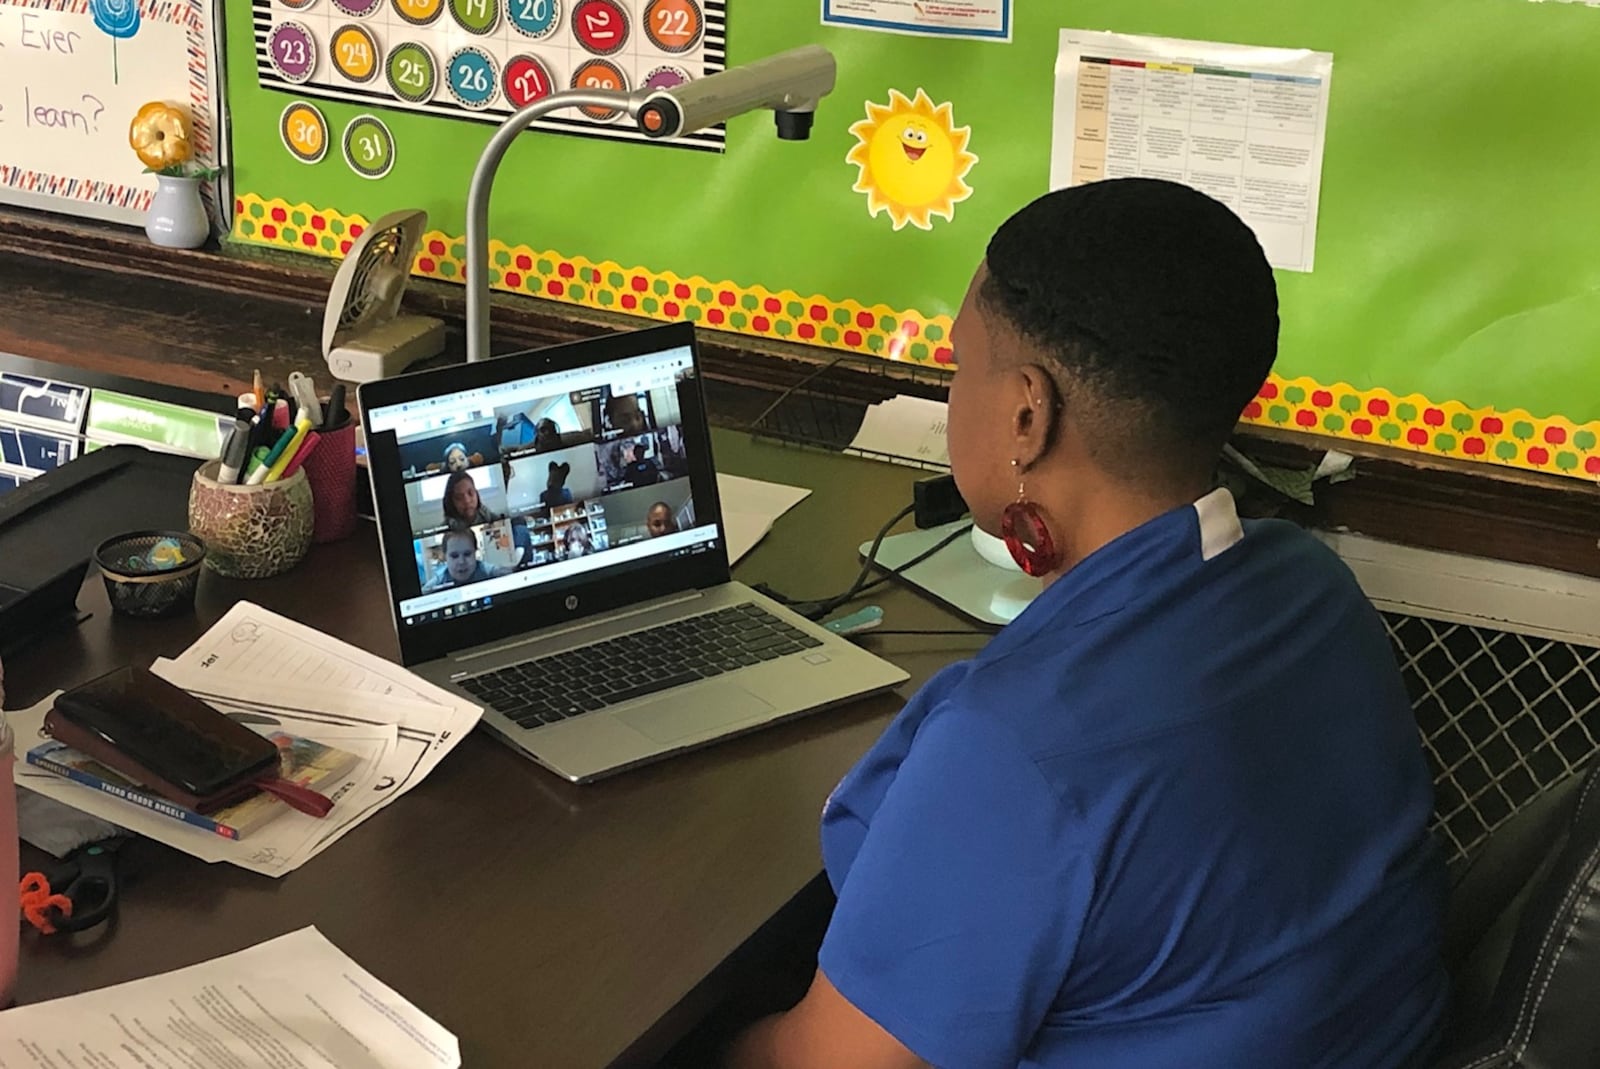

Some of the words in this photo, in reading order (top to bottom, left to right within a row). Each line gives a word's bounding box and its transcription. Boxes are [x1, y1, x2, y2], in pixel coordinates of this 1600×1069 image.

[22, 13, 81, 54] Ever
[519, 0, 548, 21] 20
[586, 11, 614, 39] 21
[657, 9, 691, 36] 22
[280, 40, 306, 65] 23
[342, 43, 368, 67] 24
[399, 59, 425, 87] 25
[459, 65, 488, 91] 26
[514, 68, 543, 102] 27
[25, 86, 104, 135] learn?
[293, 119, 319, 147] 30
[359, 134, 382, 161] 31
[101, 781, 126, 797] THIRD
